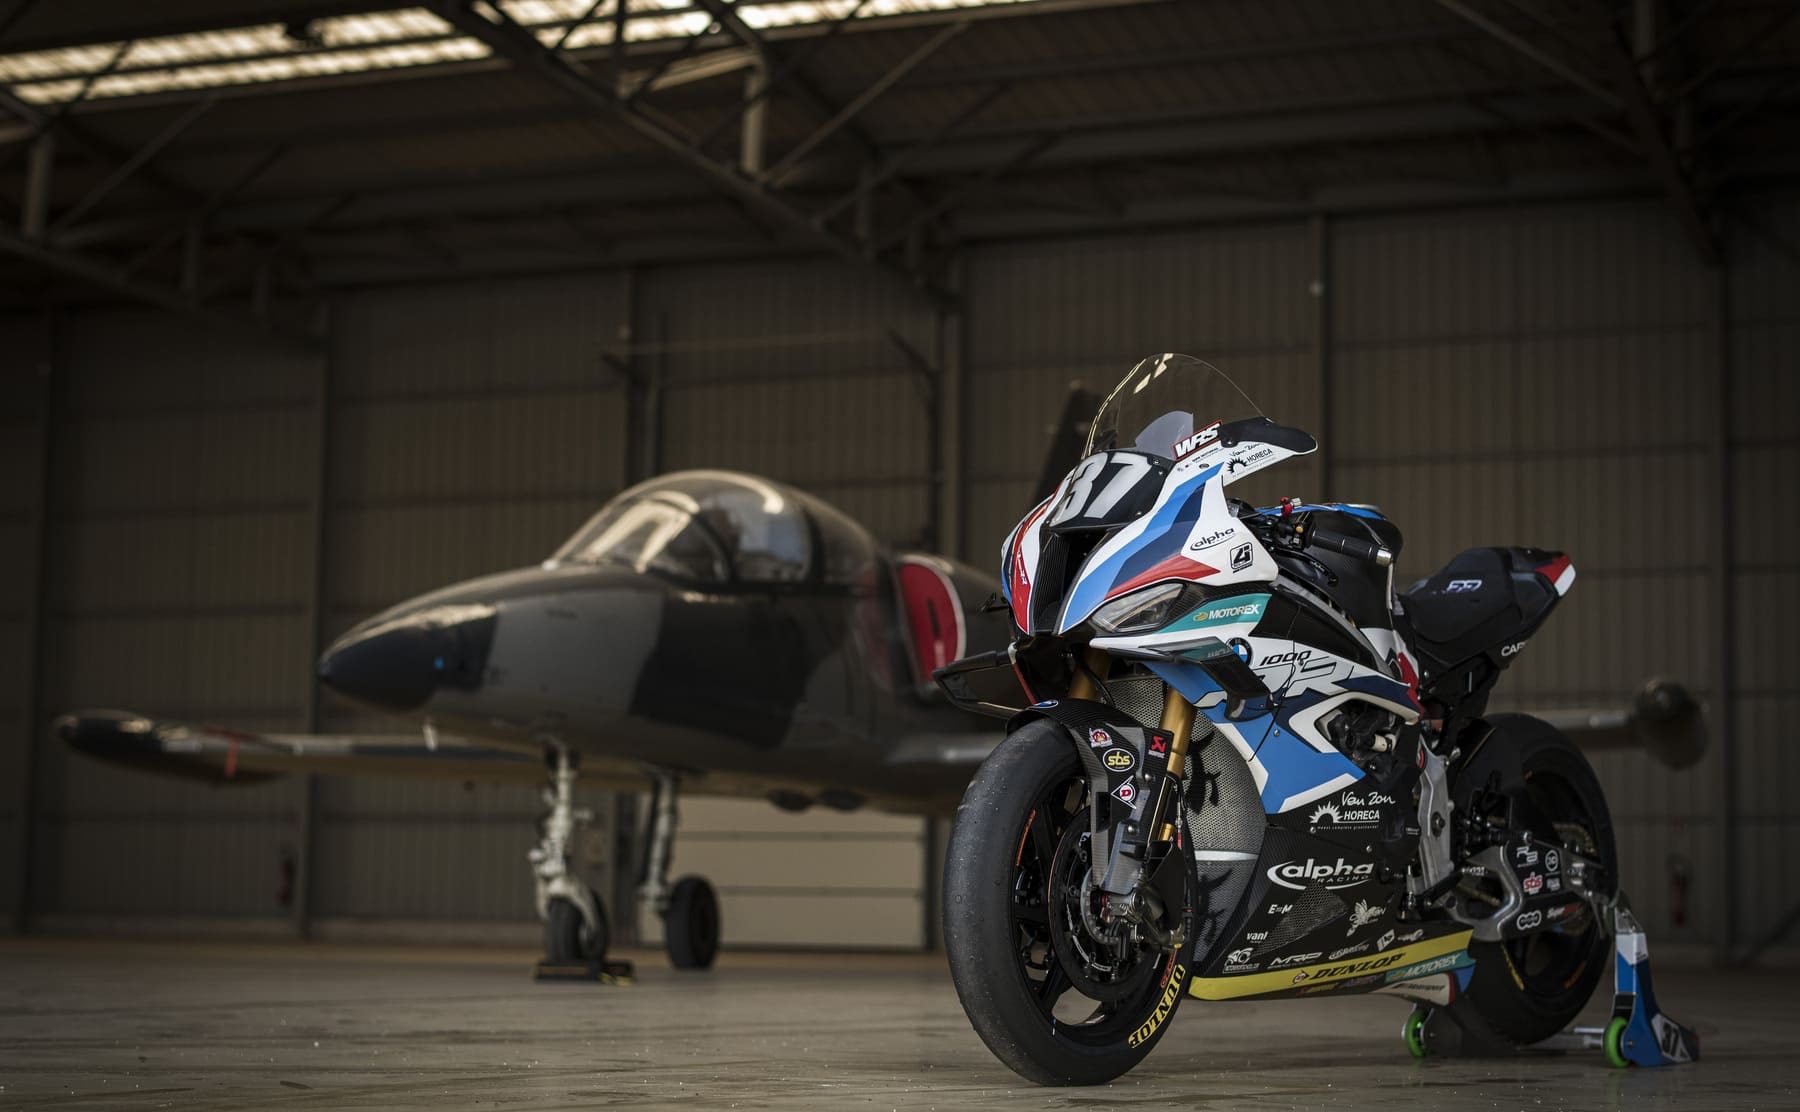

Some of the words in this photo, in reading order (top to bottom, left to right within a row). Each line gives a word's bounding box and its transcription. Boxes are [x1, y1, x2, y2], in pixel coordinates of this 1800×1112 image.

[1175, 422, 1221, 457] WRS
[1247, 448, 1273, 464] HORECA
[1048, 451, 1152, 527] 37
[1194, 528, 1235, 545] alpha
[1208, 603, 1261, 620] MOTOREX
[1107, 751, 1131, 766] sbs
[1343, 809, 1380, 820] HORECA
[1281, 858, 1374, 879] alpha
[1317, 875, 1369, 883] RACING
[1308, 953, 1408, 981] DUNLOP
[1129, 964, 1186, 1048] DUNLOP
